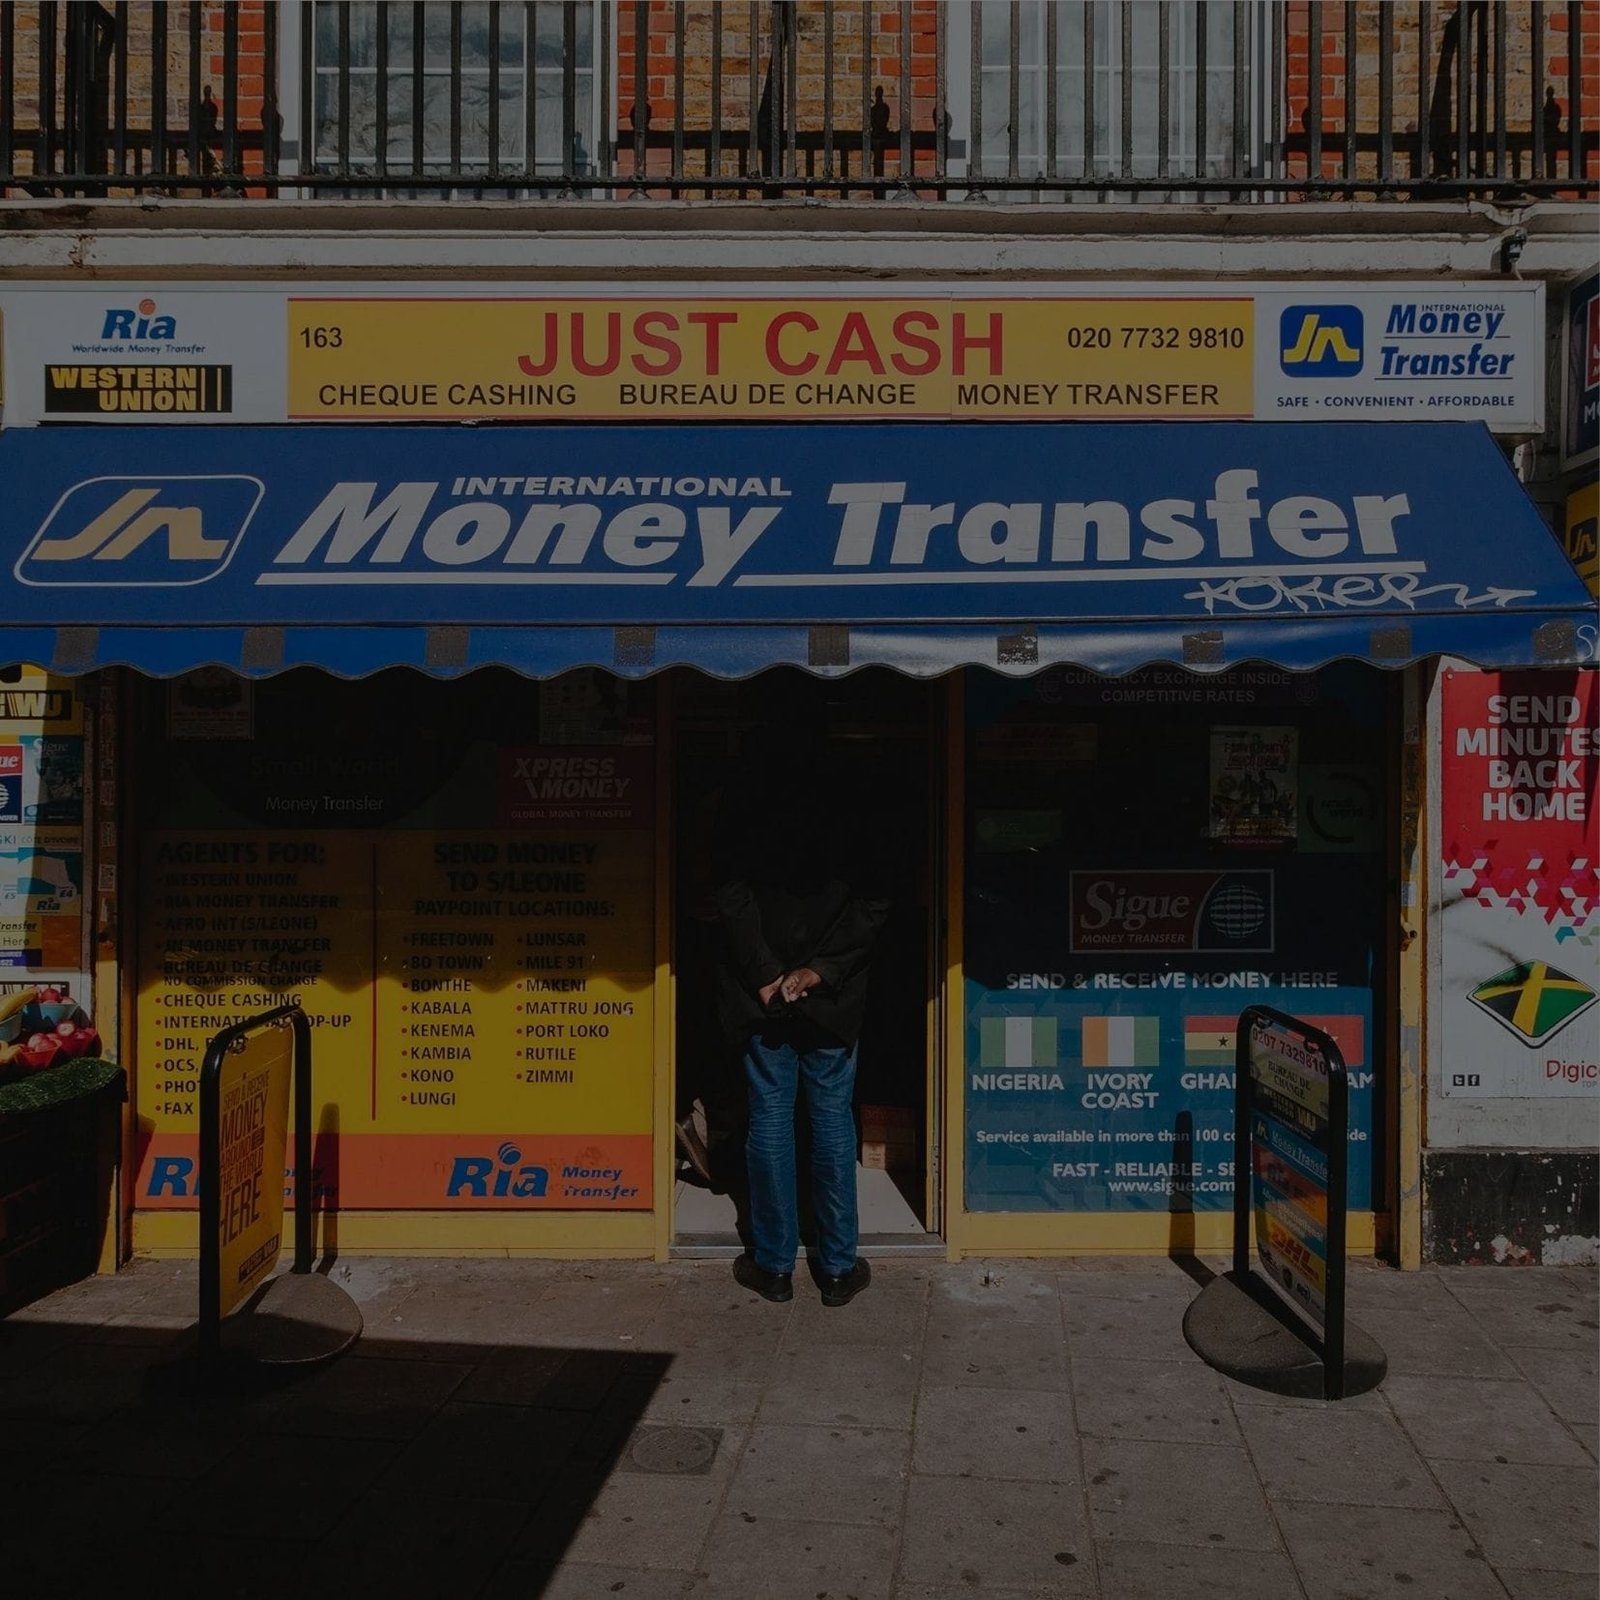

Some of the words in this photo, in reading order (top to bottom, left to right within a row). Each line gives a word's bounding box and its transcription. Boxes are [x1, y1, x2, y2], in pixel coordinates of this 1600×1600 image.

[1421, 304, 1506, 312] INTERNATIONAL
[102, 298, 176, 340] Ria
[1386, 305, 1505, 339] Money
[300, 327, 343, 348] 163
[518, 311, 738, 377] JUST
[764, 311, 1004, 377] CASH
[1067, 327, 1111, 349] 020
[1121, 327, 1180, 349] 7732
[1189, 327, 1245, 349] 9810
[72, 344, 124, 353] Worldwide
[129, 344, 161, 355] Money
[166, 344, 206, 355] Transfer
[1380, 342, 1515, 376] Transfer
[50, 367, 197, 389] WESTERN
[98, 389, 197, 412] UNION
[319, 384, 437, 407] CHEQUE
[448, 384, 576, 406] CASHING
[620, 384, 737, 405] BUREAU
[748, 384, 785, 405] DE
[796, 383, 916, 405] CHANGE
[958, 384, 1058, 405] MONEY
[1068, 384, 1219, 406] TRANSFER
[1277, 396, 1309, 407] SAFE
[1324, 396, 1414, 407] CONVENIENT
[1427, 396, 1515, 407] AFFORDABLE
[451, 475, 792, 498] INTERNATIONAL
[272, 480, 783, 587] Money
[828, 469, 1411, 567] Transfer
[1154, 673, 1237, 686] EXCHANGE
[1242, 672, 1292, 685] INSIDE
[1100, 689, 1204, 703] COMPETITIVE
[1208, 689, 1256, 703] RATES
[1487, 695, 1581, 724] SEND
[512, 757, 616, 779] XPRESS
[1489, 759, 1581, 789] BACK
[531, 778, 631, 800] MONEY
[265, 795, 318, 815] Money
[322, 795, 385, 812] Transfer
[1482, 791, 1586, 822] HOME
[510, 808, 547, 819] GLOBAL
[158, 841, 259, 864] AGENTS
[268, 841, 325, 864] FOR:
[434, 843, 499, 865] SEND
[508, 843, 598, 865] MONEY
[246, 873, 297, 887] UNION
[448, 871, 480, 893] TO
[487, 871, 587, 895] S/LEONE
[196, 895, 252, 908] MONEY
[258, 895, 339, 908] TRANSFER
[415, 900, 502, 916] PAYPOINT
[509, 900, 616, 917] LOCATIONS:
[1080, 879, 1191, 932] Sigue
[164, 916, 207, 931] AFRO
[211, 917, 239, 931] INT
[241, 915, 319, 932] (S/LEONE)
[3, 936, 30, 946] Here
[411, 932, 494, 946] FREETOWN
[526, 932, 587, 946] LUNSAR
[1080, 934, 1125, 945] MONEY
[1127, 934, 1186, 945] TRANSFER
[163, 960, 227, 974] BUREAU
[231, 960, 252, 974] DE
[257, 960, 323, 974] CHANGE
[438, 955, 483, 970] TOWN
[525, 955, 562, 970] MILE
[567, 955, 585, 970] 91
[164, 975, 182, 986] NO
[185, 975, 266, 987] COMMISSION
[269, 975, 319, 987] CHARGE
[411, 978, 473, 992] BONTHE
[526, 978, 587, 993] MAKENI
[1006, 972, 1066, 990] SEND
[1072, 972, 1088, 990] &
[1095, 972, 1186, 990] RECEIVE
[1193, 972, 1273, 990] MONEY
[1281, 972, 1339, 989] HERE
[163, 993, 227, 1007] CHEQUE
[231, 993, 302, 1007] CASHING
[410, 1001, 473, 1015] KABALA
[525, 1001, 588, 1015] MATTRU
[592, 1001, 634, 1016] JONG
[305, 1015, 353, 1028] OP-UP
[410, 1024, 476, 1038] KENEMA
[525, 1024, 565, 1038] PORT
[569, 1024, 610, 1038] LOKO
[164, 1037, 200, 1052] DHL,
[410, 1047, 472, 1061] KAMBIA
[525, 1047, 577, 1061] RUTILE
[164, 1058, 199, 1073] OCS,
[410, 1069, 455, 1083] KONO
[525, 1070, 575, 1084] ZIMMI
[971, 1073, 1065, 1091] NIGERIA
[1087, 1073, 1154, 1090] IVORY
[410, 1092, 457, 1106] LUNGI
[1081, 1092, 1160, 1110] COAST
[164, 1102, 194, 1115] FAX
[221, 1087, 269, 1152] MONEY
[975, 1130, 1030, 1144] Service
[1033, 1130, 1095, 1144] available
[1098, 1130, 1112, 1143] in
[1115, 1131, 1154, 1143] more
[1158, 1129, 1190, 1143] than
[1194, 1129, 1220, 1143] 100
[446, 1141, 549, 1198] Ria
[562, 1165, 623, 1181] Money
[1053, 1163, 1100, 1178] FAST
[1115, 1163, 1202, 1177] RELIABLE
[1108, 1178, 1236, 1196] www.sigue.com
